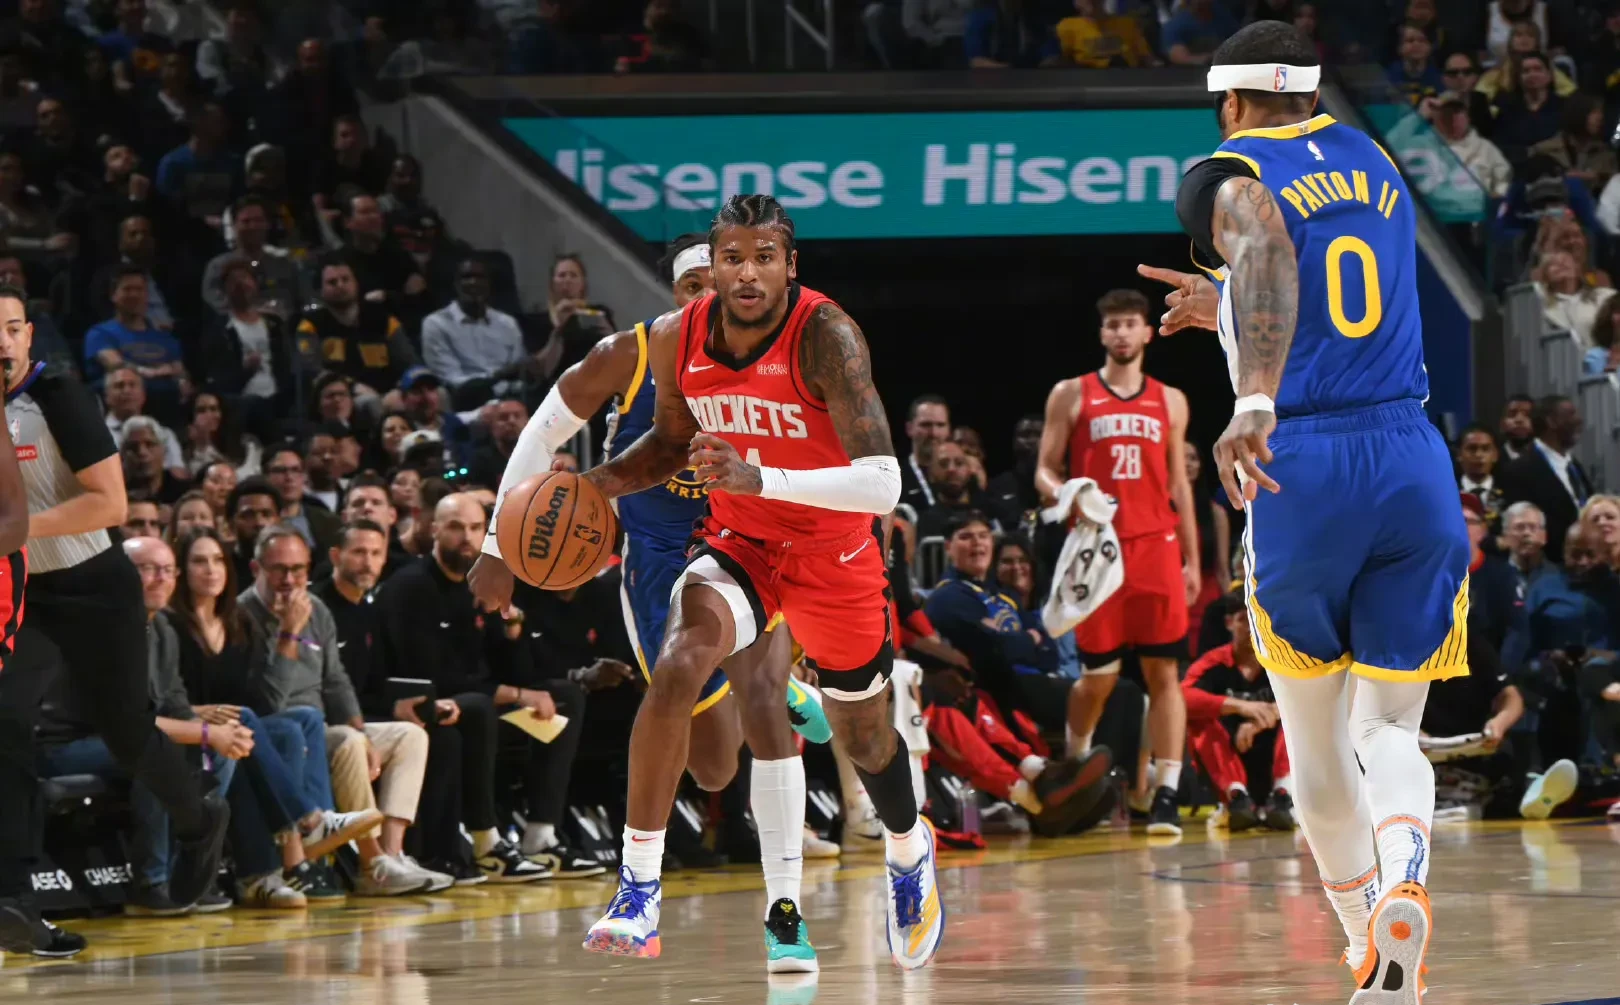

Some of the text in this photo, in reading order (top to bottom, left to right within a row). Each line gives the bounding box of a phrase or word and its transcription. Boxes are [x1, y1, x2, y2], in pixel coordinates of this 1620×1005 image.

[1280, 169, 1370, 219] PAYTON
[1377, 180, 1399, 220] II
[1325, 235, 1382, 338] 0
[1090, 413, 1161, 443] ROCKETS
[1111, 444, 1141, 480] 28
[528, 486, 569, 559] Wilson
